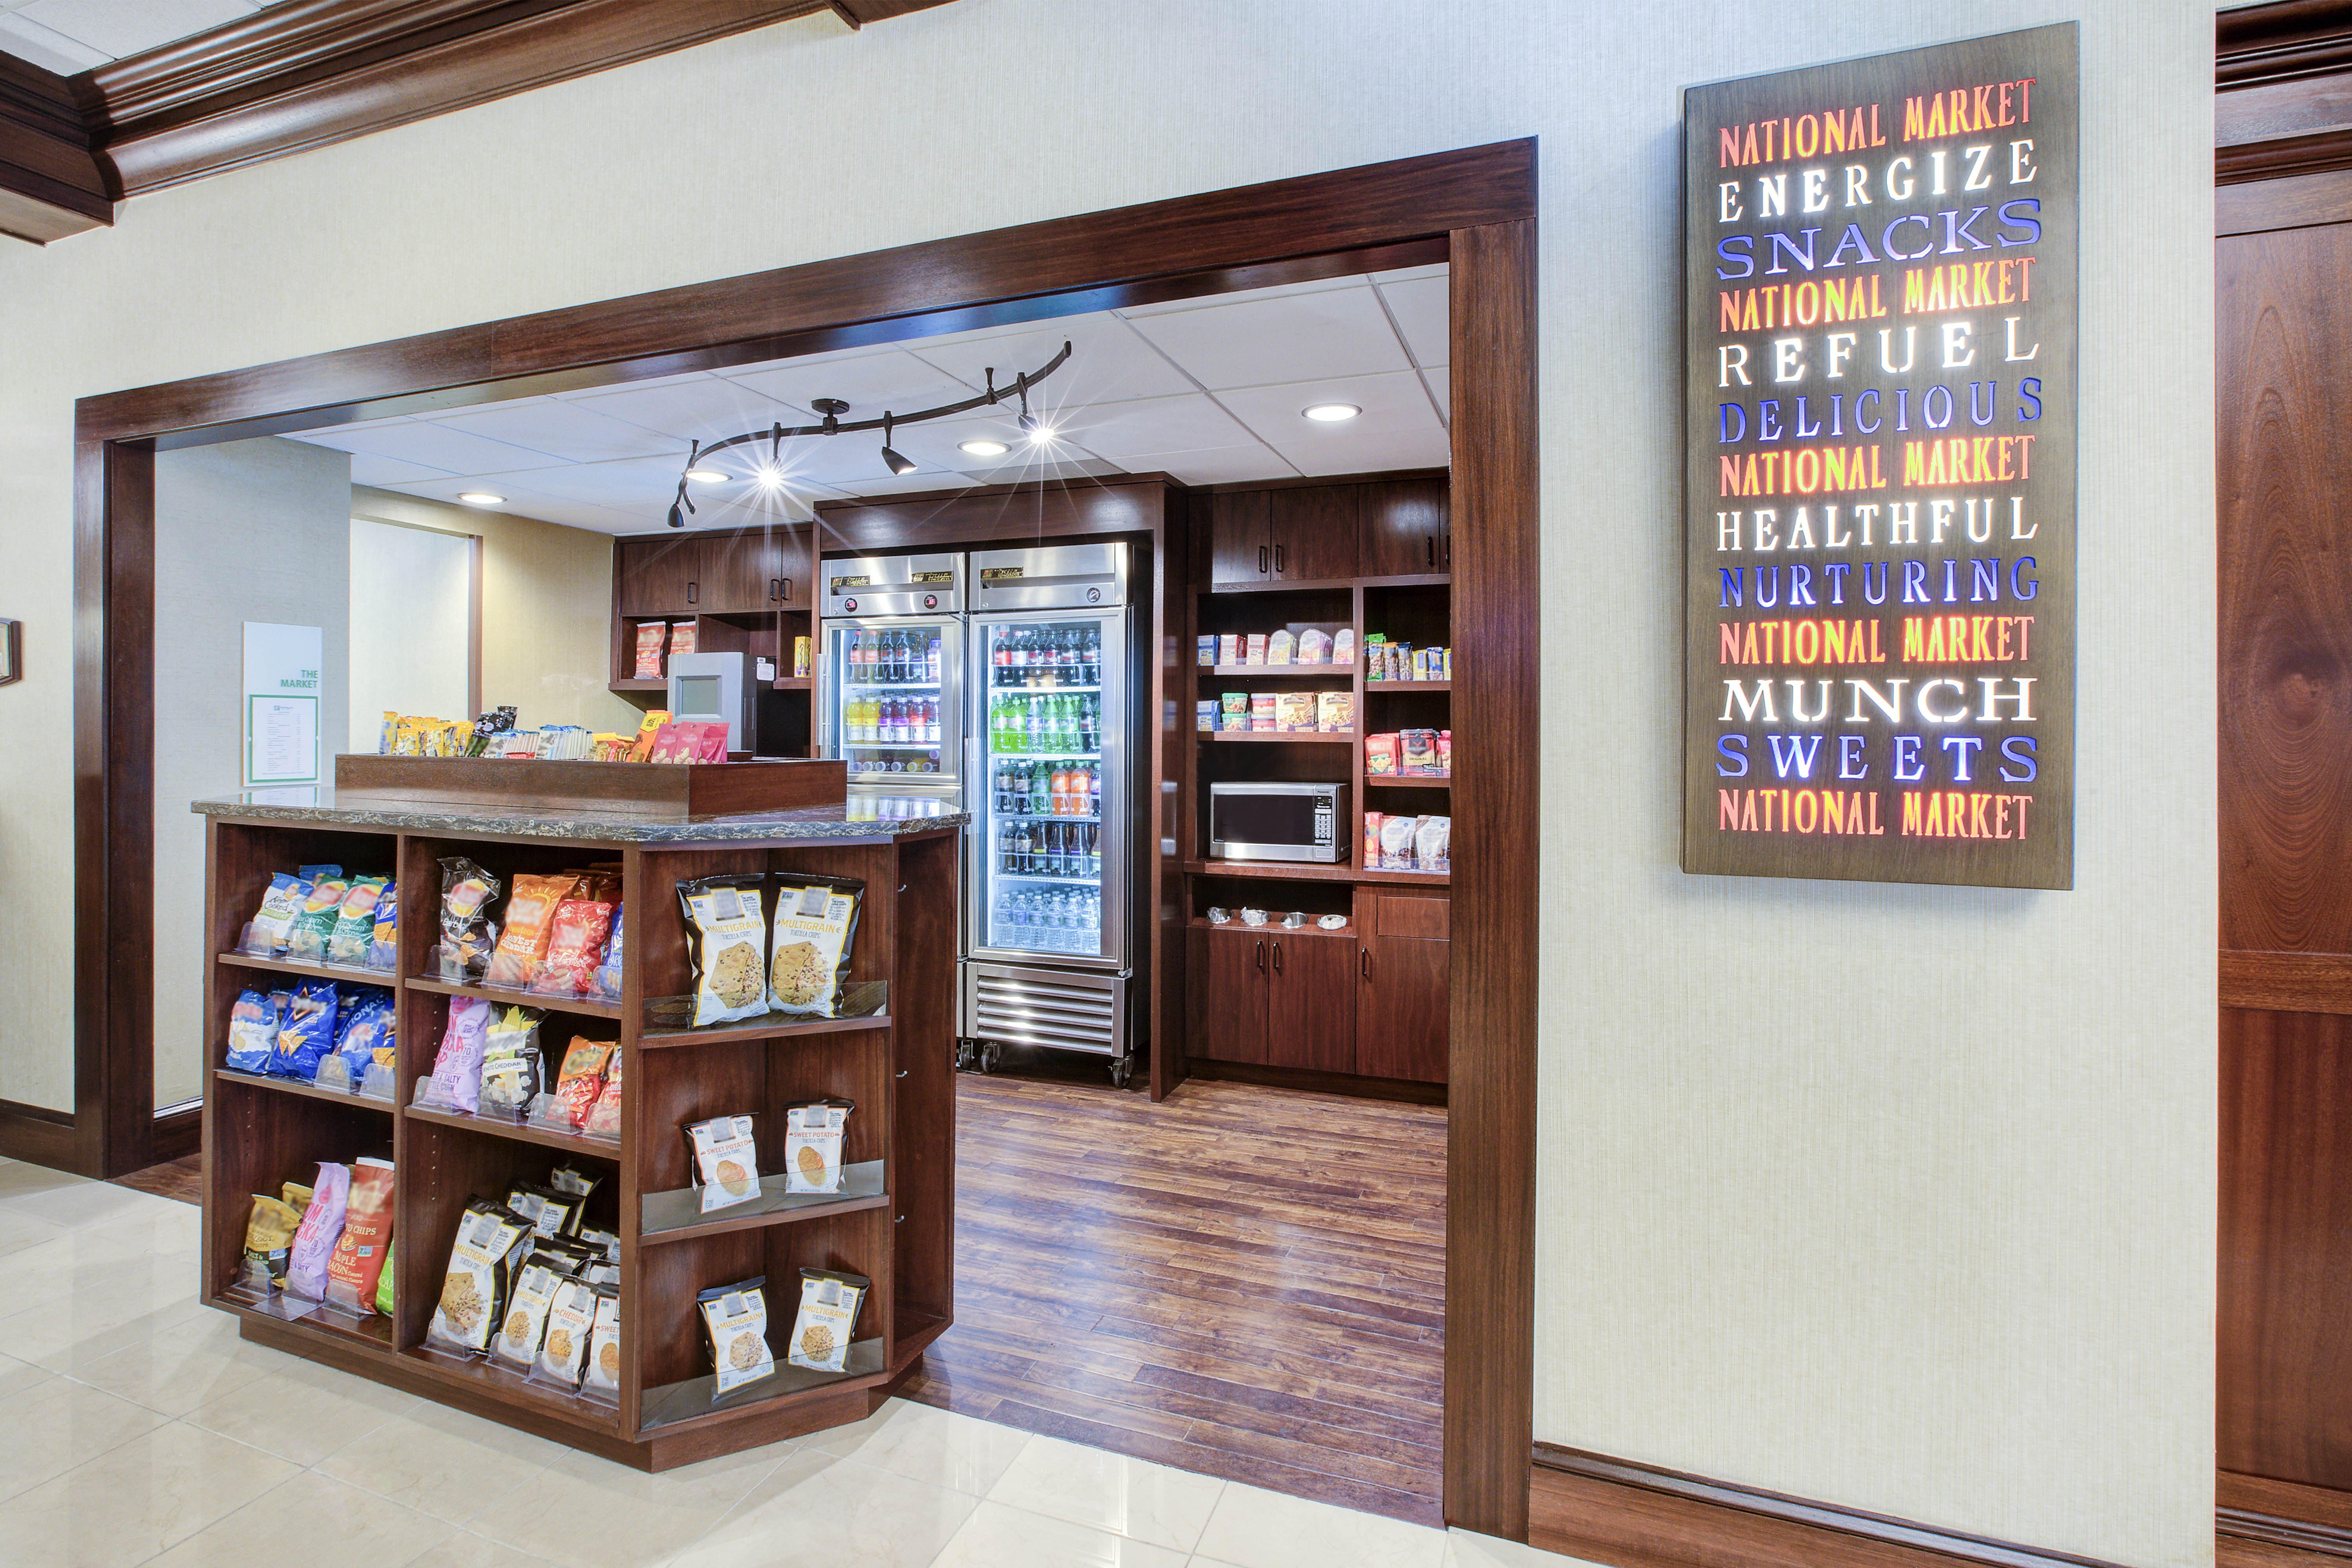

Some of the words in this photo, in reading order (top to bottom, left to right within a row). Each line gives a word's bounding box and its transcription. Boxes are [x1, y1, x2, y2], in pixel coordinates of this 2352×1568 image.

[1719, 103, 1886, 168] NATIONAL
[1904, 77, 2036, 142] MARKET
[1719, 139, 2037, 223] ENERGIZE
[1716, 199, 2041, 281] SNACKS
[1720, 274, 1886, 332] NATIONAL
[1904, 256, 2036, 314] MARKET
[1718, 316, 2040, 387] REFUEL
[1719, 377, 2042, 443] DELICIOUS
[1720, 445, 1887, 497] NATIONAL
[1904, 434, 2036, 487] MARKET
[1716, 496, 2039, 551] HEALTHFUL
[1719, 556, 2039, 608] NURTURING
[1720, 619, 1886, 664] NATIONAL
[1903, 616, 2034, 662] MARKET
[301, 670, 318, 678] THE
[281, 679, 318, 688] MARKET
[1718, 677, 2038, 723] MUNCH
[1716, 734, 2038, 782] SWEETS
[1719, 788, 1884, 835] NATIONAL
[1901, 791, 2033, 840] MARKET
[709, 920, 759, 933] MULTIGRAIN
[780, 919, 835, 933] MULTIGRAIN
[501, 939, 535, 954] CHEDDAR
[505, 932, 537, 947] HAVEST
[429, 1081, 439, 1090] TTLE
[440, 1082, 455, 1092] CORN
[445, 1074, 461, 1083] SALTY
[707, 1146, 724, 1154] SWEET
[726, 1140, 748, 1151] POTATO
[304, 1202, 324, 1222] OM
[297, 1221, 319, 1243] CKA
[353, 1225, 376, 1235] CHIPS
[333, 1250, 356, 1266] MPLE
[455, 1244, 491, 1266] MULTIGRAIN
[518, 1290, 543, 1306] MULTIGRAIN
[559, 1309, 583, 1324] CHEDDAR
[804, 1305, 845, 1319] MULTIGRAIN
[601, 1325, 620, 1333] SWEET
[720, 1313, 760, 1330] MULTIGRAIN
